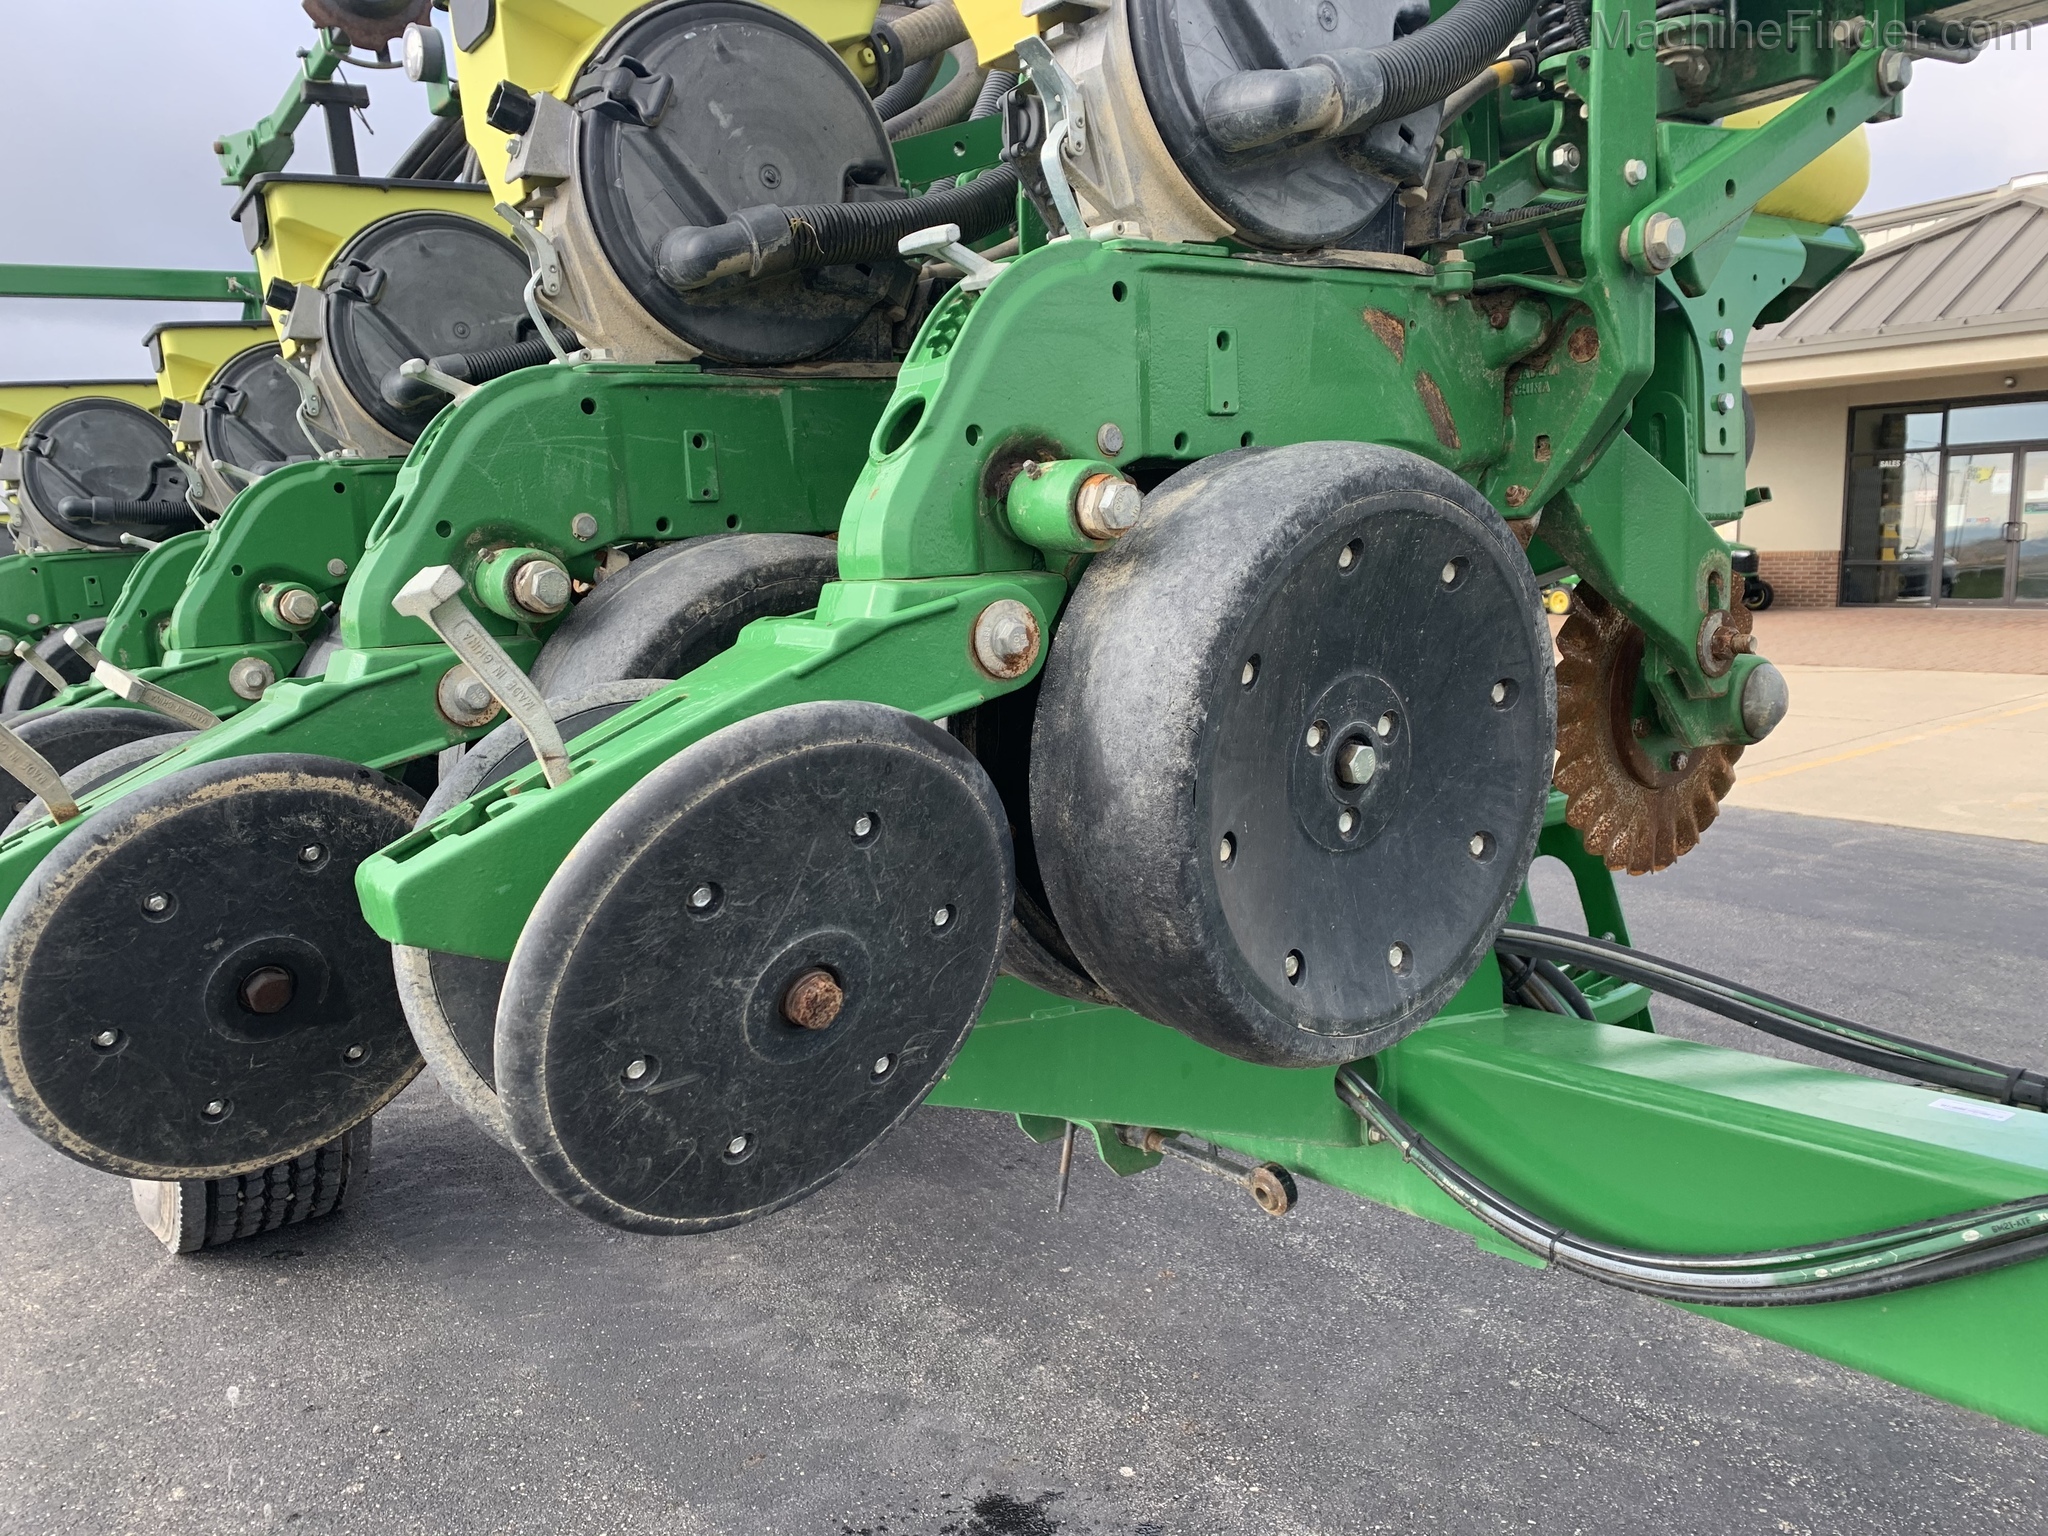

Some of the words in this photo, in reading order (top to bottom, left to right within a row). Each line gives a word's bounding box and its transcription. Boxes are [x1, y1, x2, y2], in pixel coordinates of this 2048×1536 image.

[1513, 380, 1551, 396] CHINA
[1880, 460, 1901, 468] SALES
[462, 631, 494, 665] CHINA
[492, 666, 508, 680] IN
[149, 691, 175, 711] CHINA
[506, 682, 537, 712] MADE
[186, 708, 209, 725] MADE
[21, 760, 49, 786] MADE
